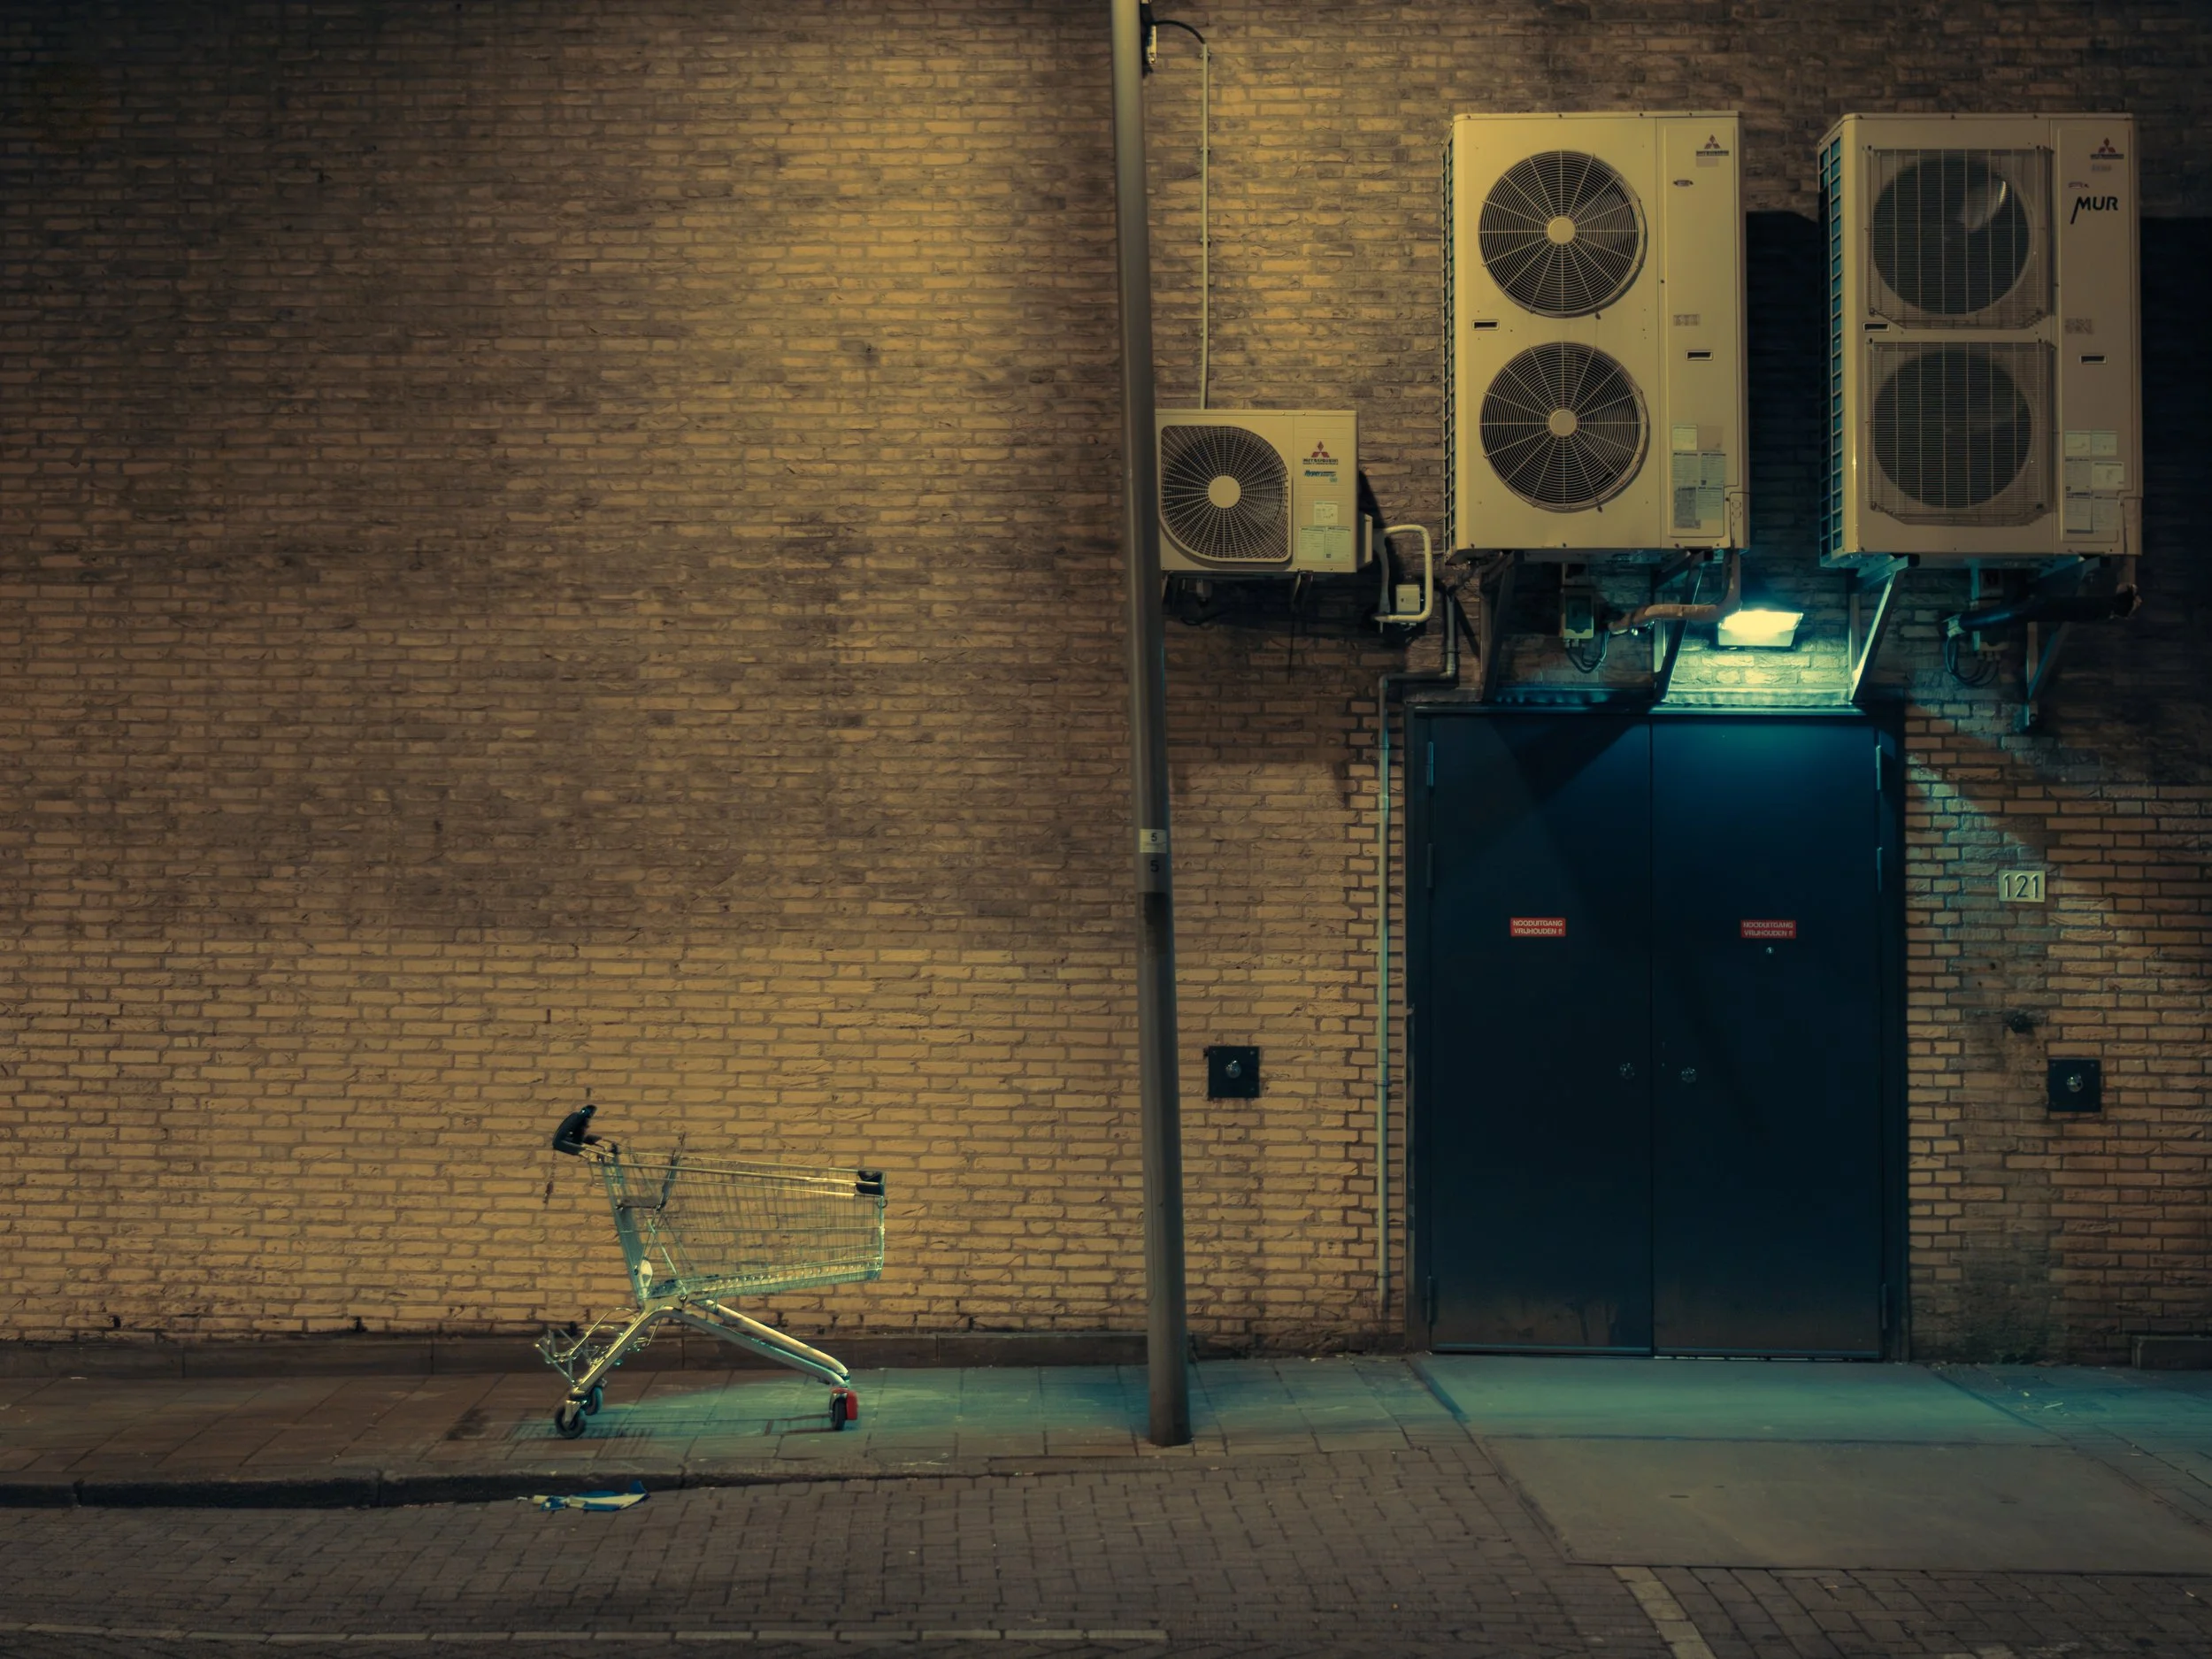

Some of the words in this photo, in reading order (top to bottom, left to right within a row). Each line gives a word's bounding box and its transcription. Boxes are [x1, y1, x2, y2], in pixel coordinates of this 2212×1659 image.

[2070, 196, 2119, 225] MUR
[1151, 833, 1158, 841] 5
[1150, 860, 1159, 872] 5
[2002, 873, 2039, 898] 121
